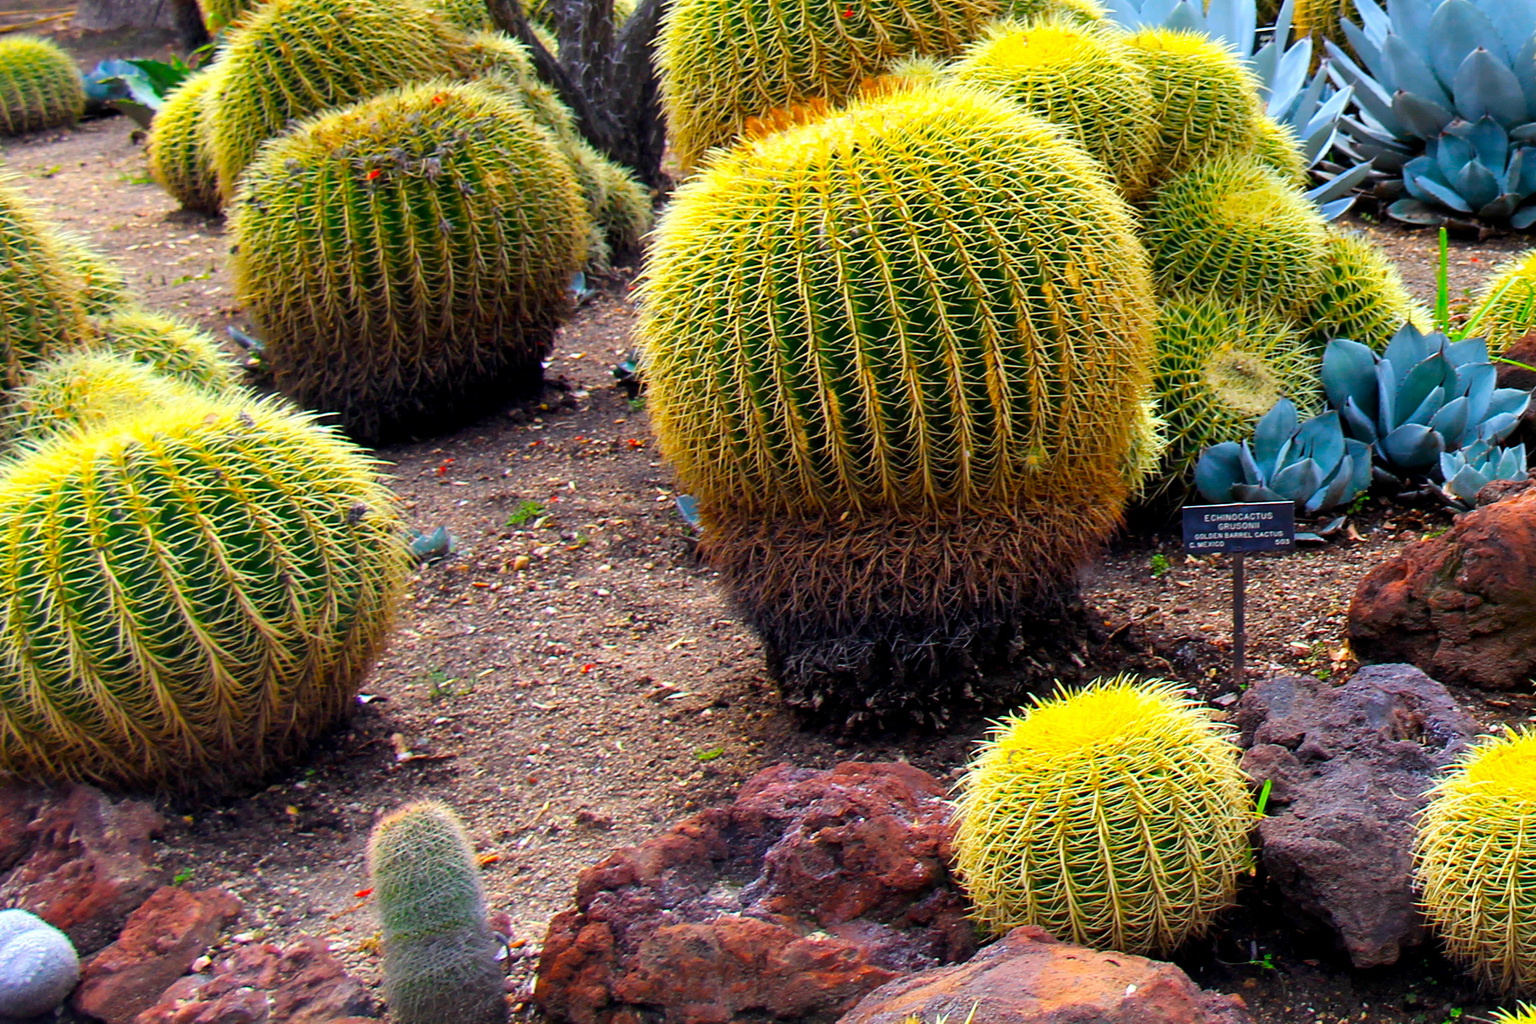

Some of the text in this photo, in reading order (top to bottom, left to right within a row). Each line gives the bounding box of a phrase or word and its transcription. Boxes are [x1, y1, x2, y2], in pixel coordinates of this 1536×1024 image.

[1204, 512, 1273, 522] ECHINOCACTUS
[1217, 522, 1260, 530] GRUSONII
[1194, 530, 1284, 540] GOLDEN BARREL CACTUS
[1197, 540, 1225, 548] MEXICO
